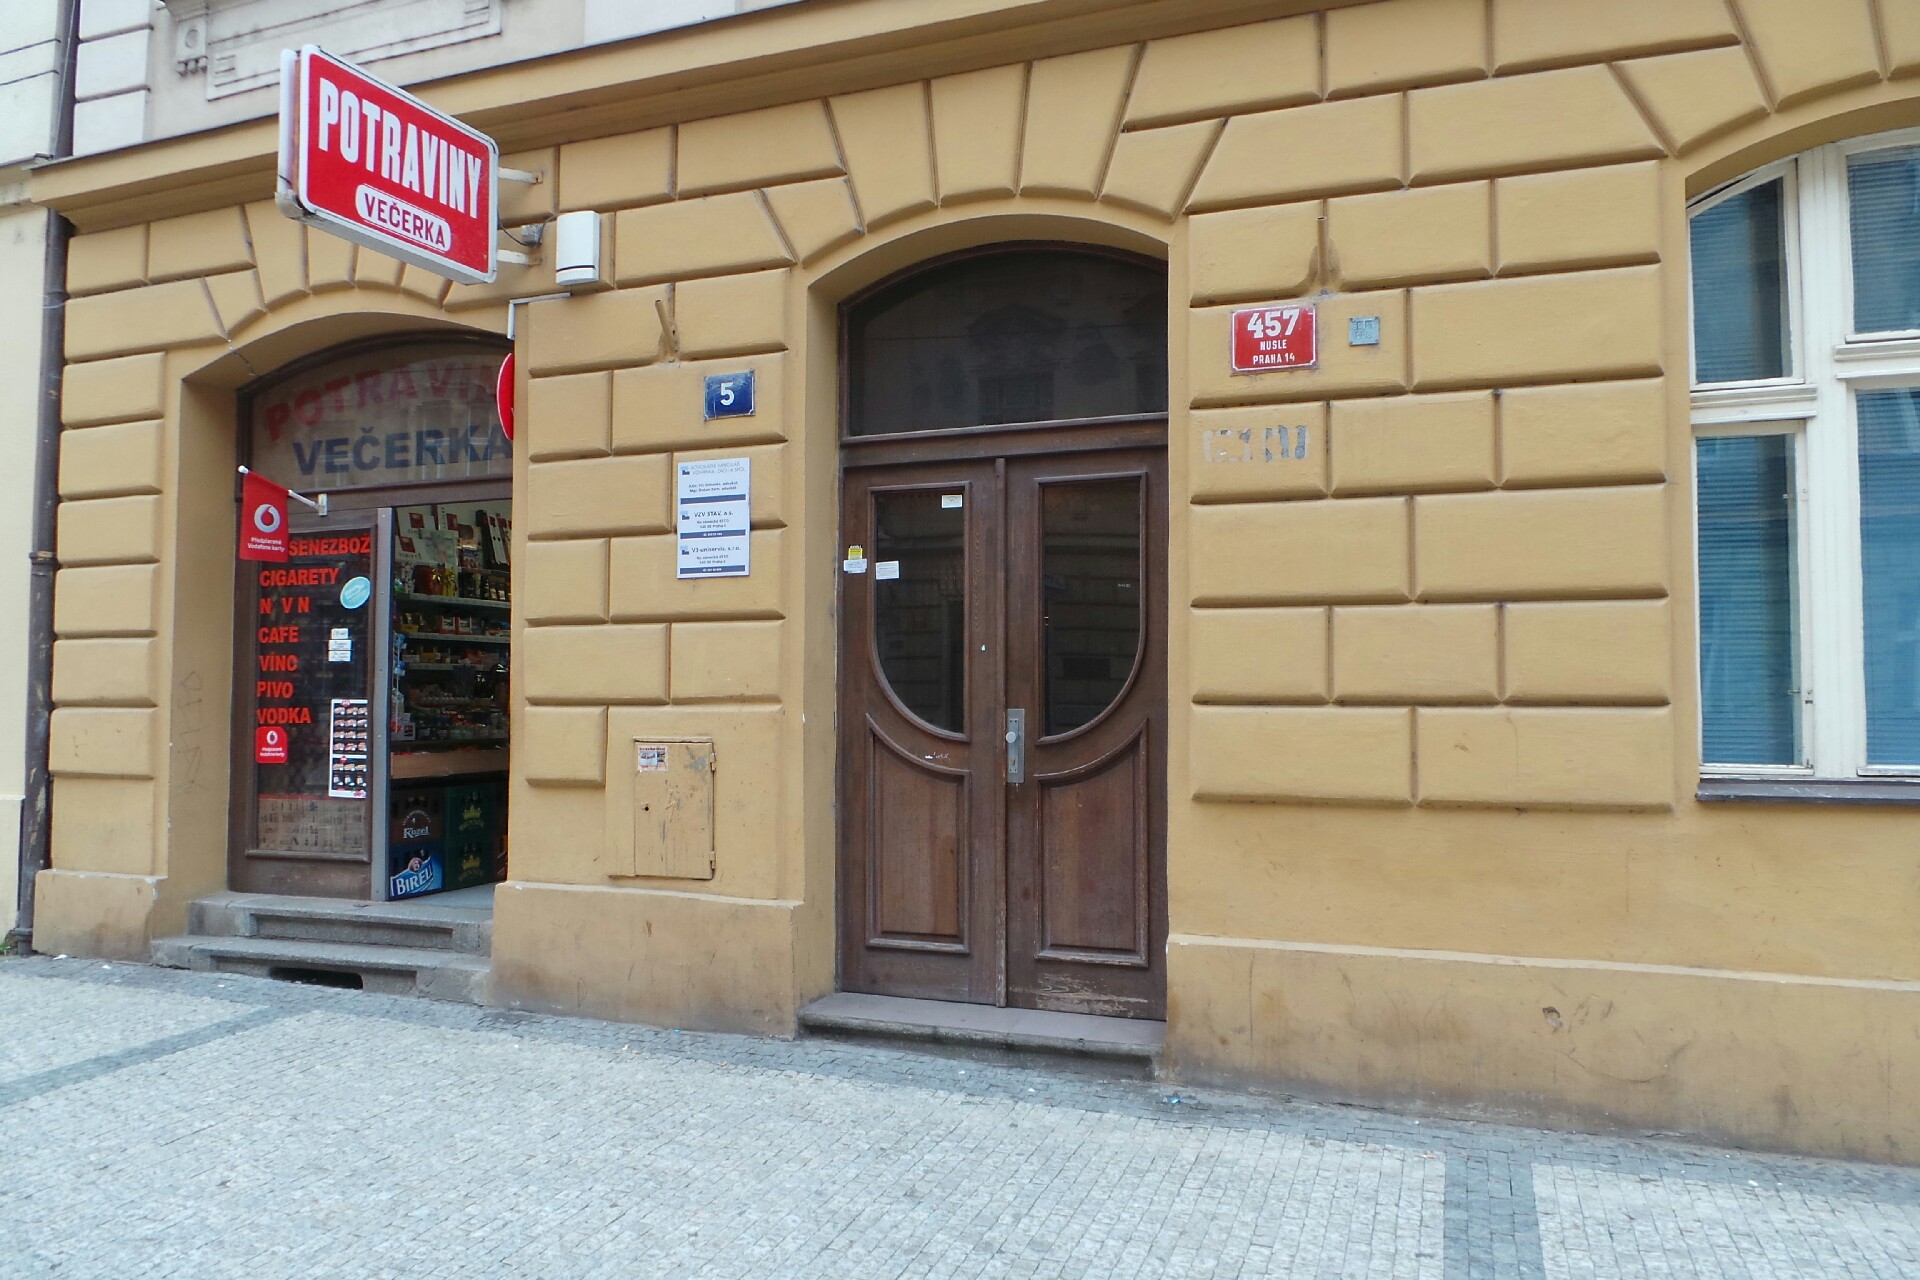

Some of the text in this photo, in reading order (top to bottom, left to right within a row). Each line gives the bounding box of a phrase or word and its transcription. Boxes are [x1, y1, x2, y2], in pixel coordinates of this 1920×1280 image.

[318, 77, 482, 219] POTRAVINY
[364, 192, 446, 248] VEČERKA
[1247, 308, 1300, 339] 457
[1260, 339, 1287, 351] NUSLE
[1253, 352, 1295, 365] PRAHA 14
[264, 361, 498, 442] POTRAVIN
[720, 381, 735, 406] 5
[292, 426, 513, 476] VEČERKA
[259, 567, 340, 588] CIGARETY
[258, 626, 300, 643] CAFE
[257, 681, 294, 698] PIVO
[257, 707, 312, 724] VODKA
[403, 826, 430, 839] Kozel
[396, 864, 433, 895] BIRELL
